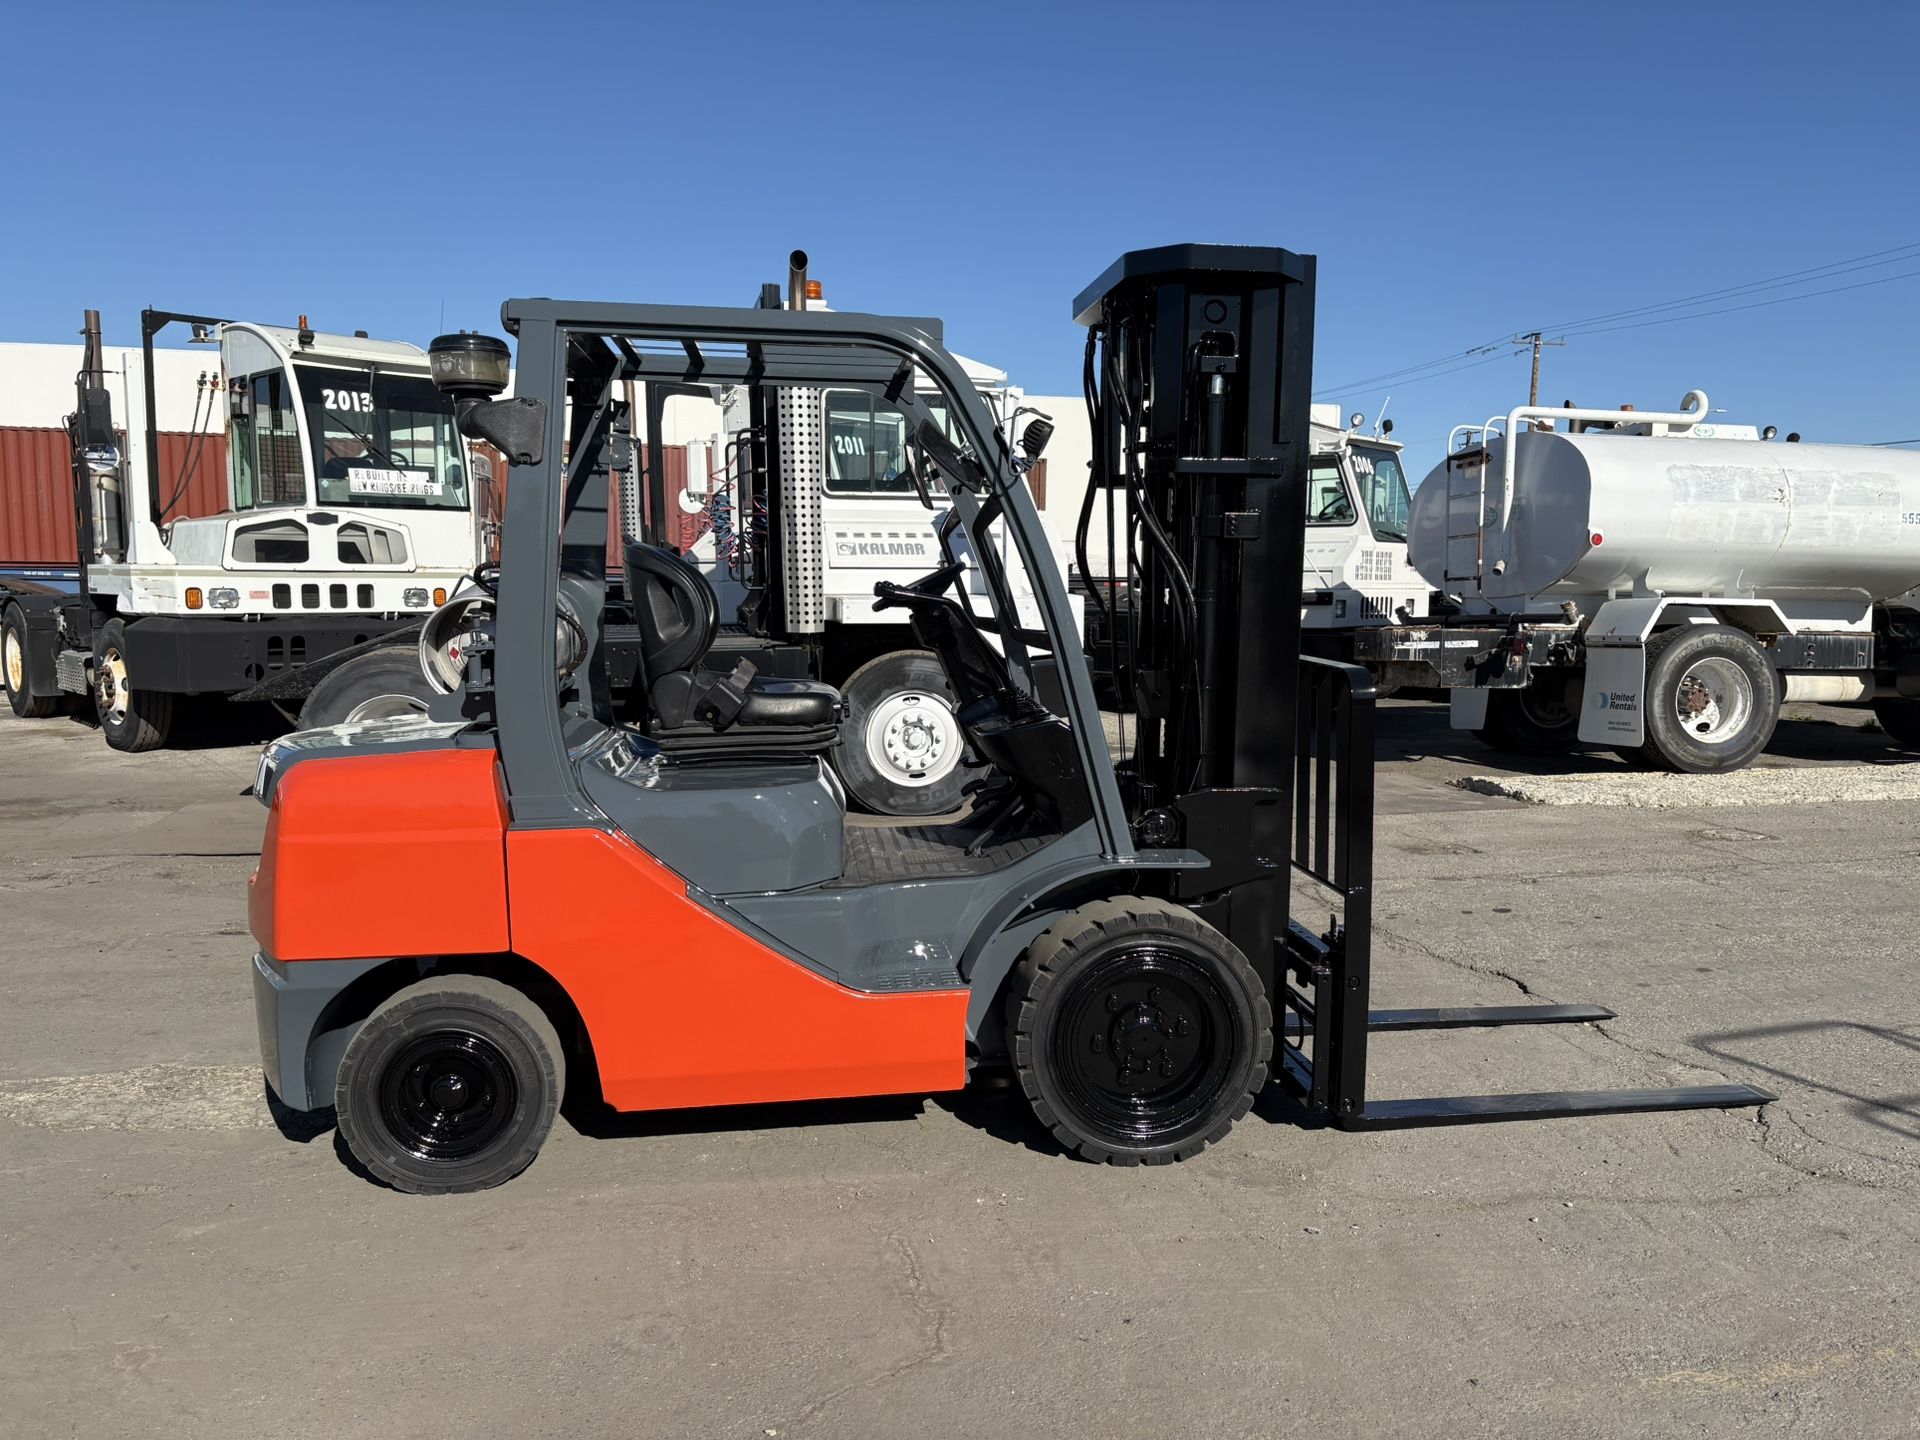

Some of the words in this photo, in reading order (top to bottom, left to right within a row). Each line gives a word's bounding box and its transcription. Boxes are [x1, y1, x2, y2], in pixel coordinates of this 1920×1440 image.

[322, 389, 374, 412] 2013
[834, 435, 866, 456] 2011
[858, 543, 926, 555] KALMAR
[1610, 692, 1636, 702] United
[1609, 701, 1638, 711] Rentals
